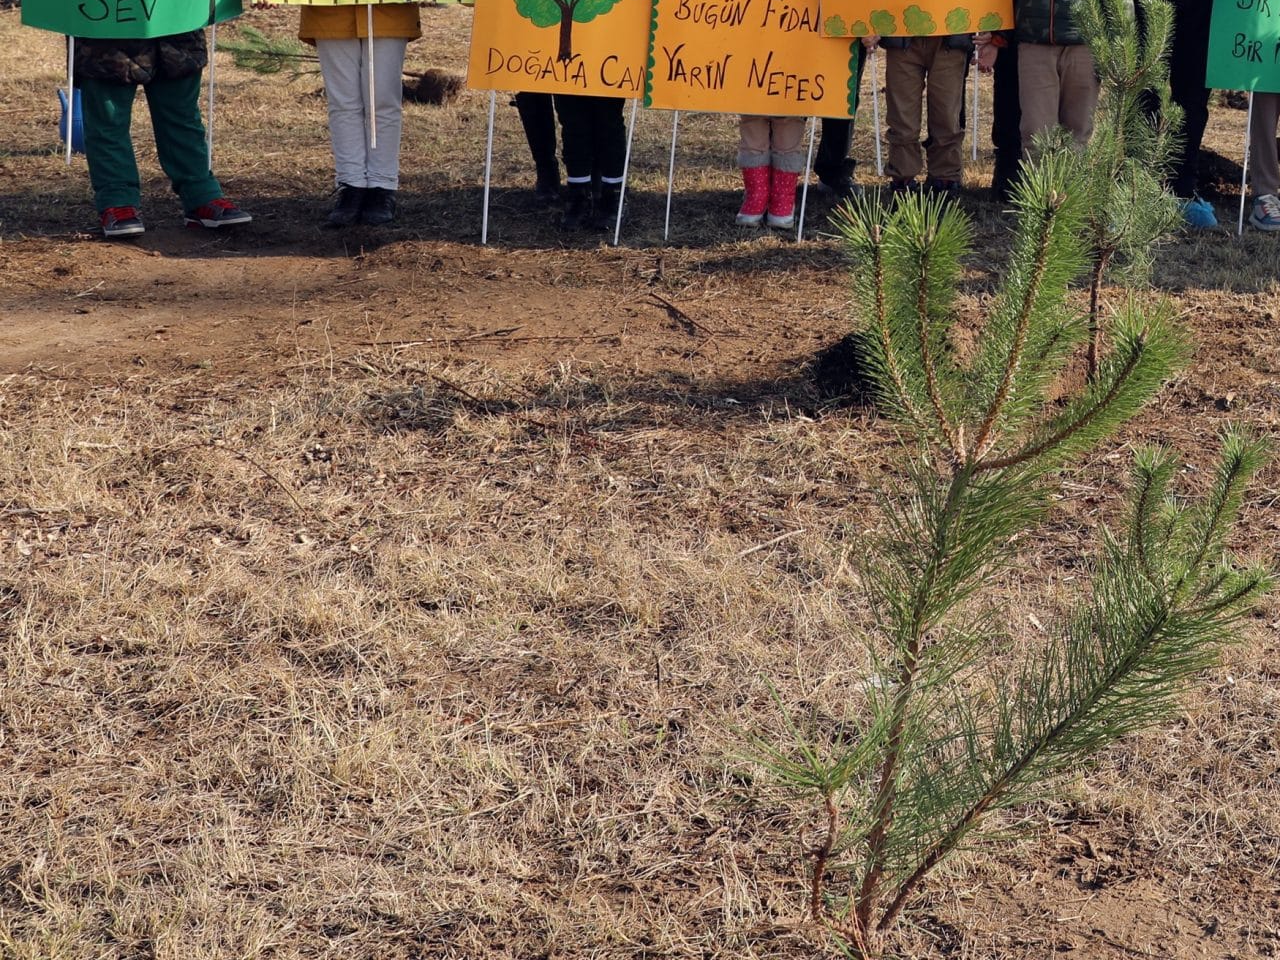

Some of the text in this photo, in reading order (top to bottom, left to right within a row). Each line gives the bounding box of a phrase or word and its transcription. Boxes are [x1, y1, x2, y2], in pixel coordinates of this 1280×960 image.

[485, 47, 588, 88] DOĞAYA
[1232, 33, 1263, 64] BİR
[747, 51, 825, 102] NEFES
